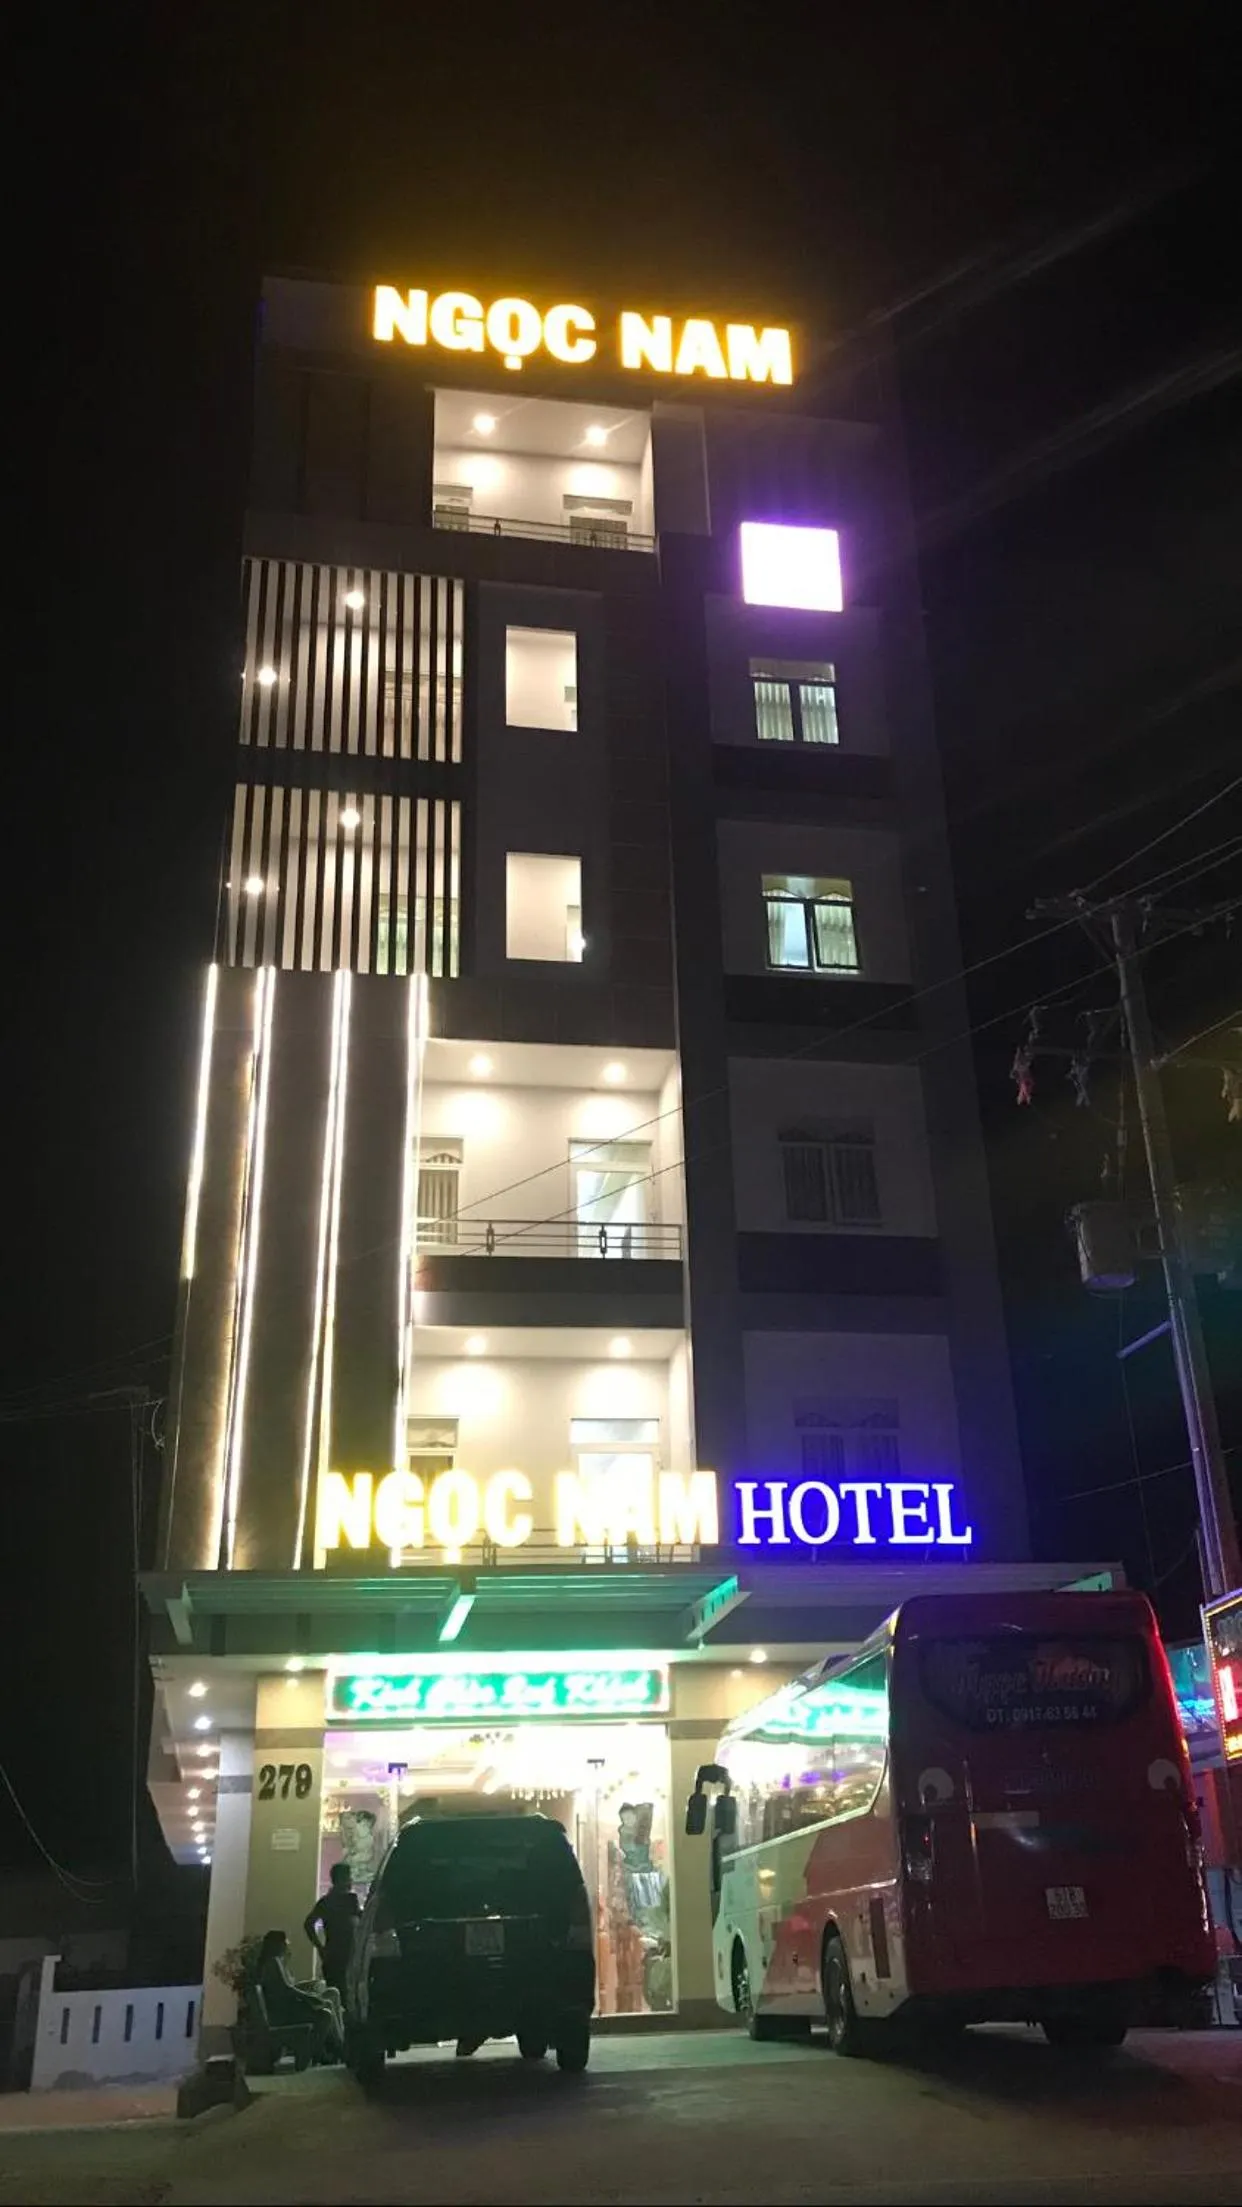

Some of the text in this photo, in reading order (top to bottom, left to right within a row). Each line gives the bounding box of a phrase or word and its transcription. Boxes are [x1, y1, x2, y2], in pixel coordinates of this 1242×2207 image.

[373, 285, 793, 384] NGỌC NAM
[320, 1470, 972, 1563] NGỌC NAM HOTEL
[258, 1763, 313, 1801] 279
